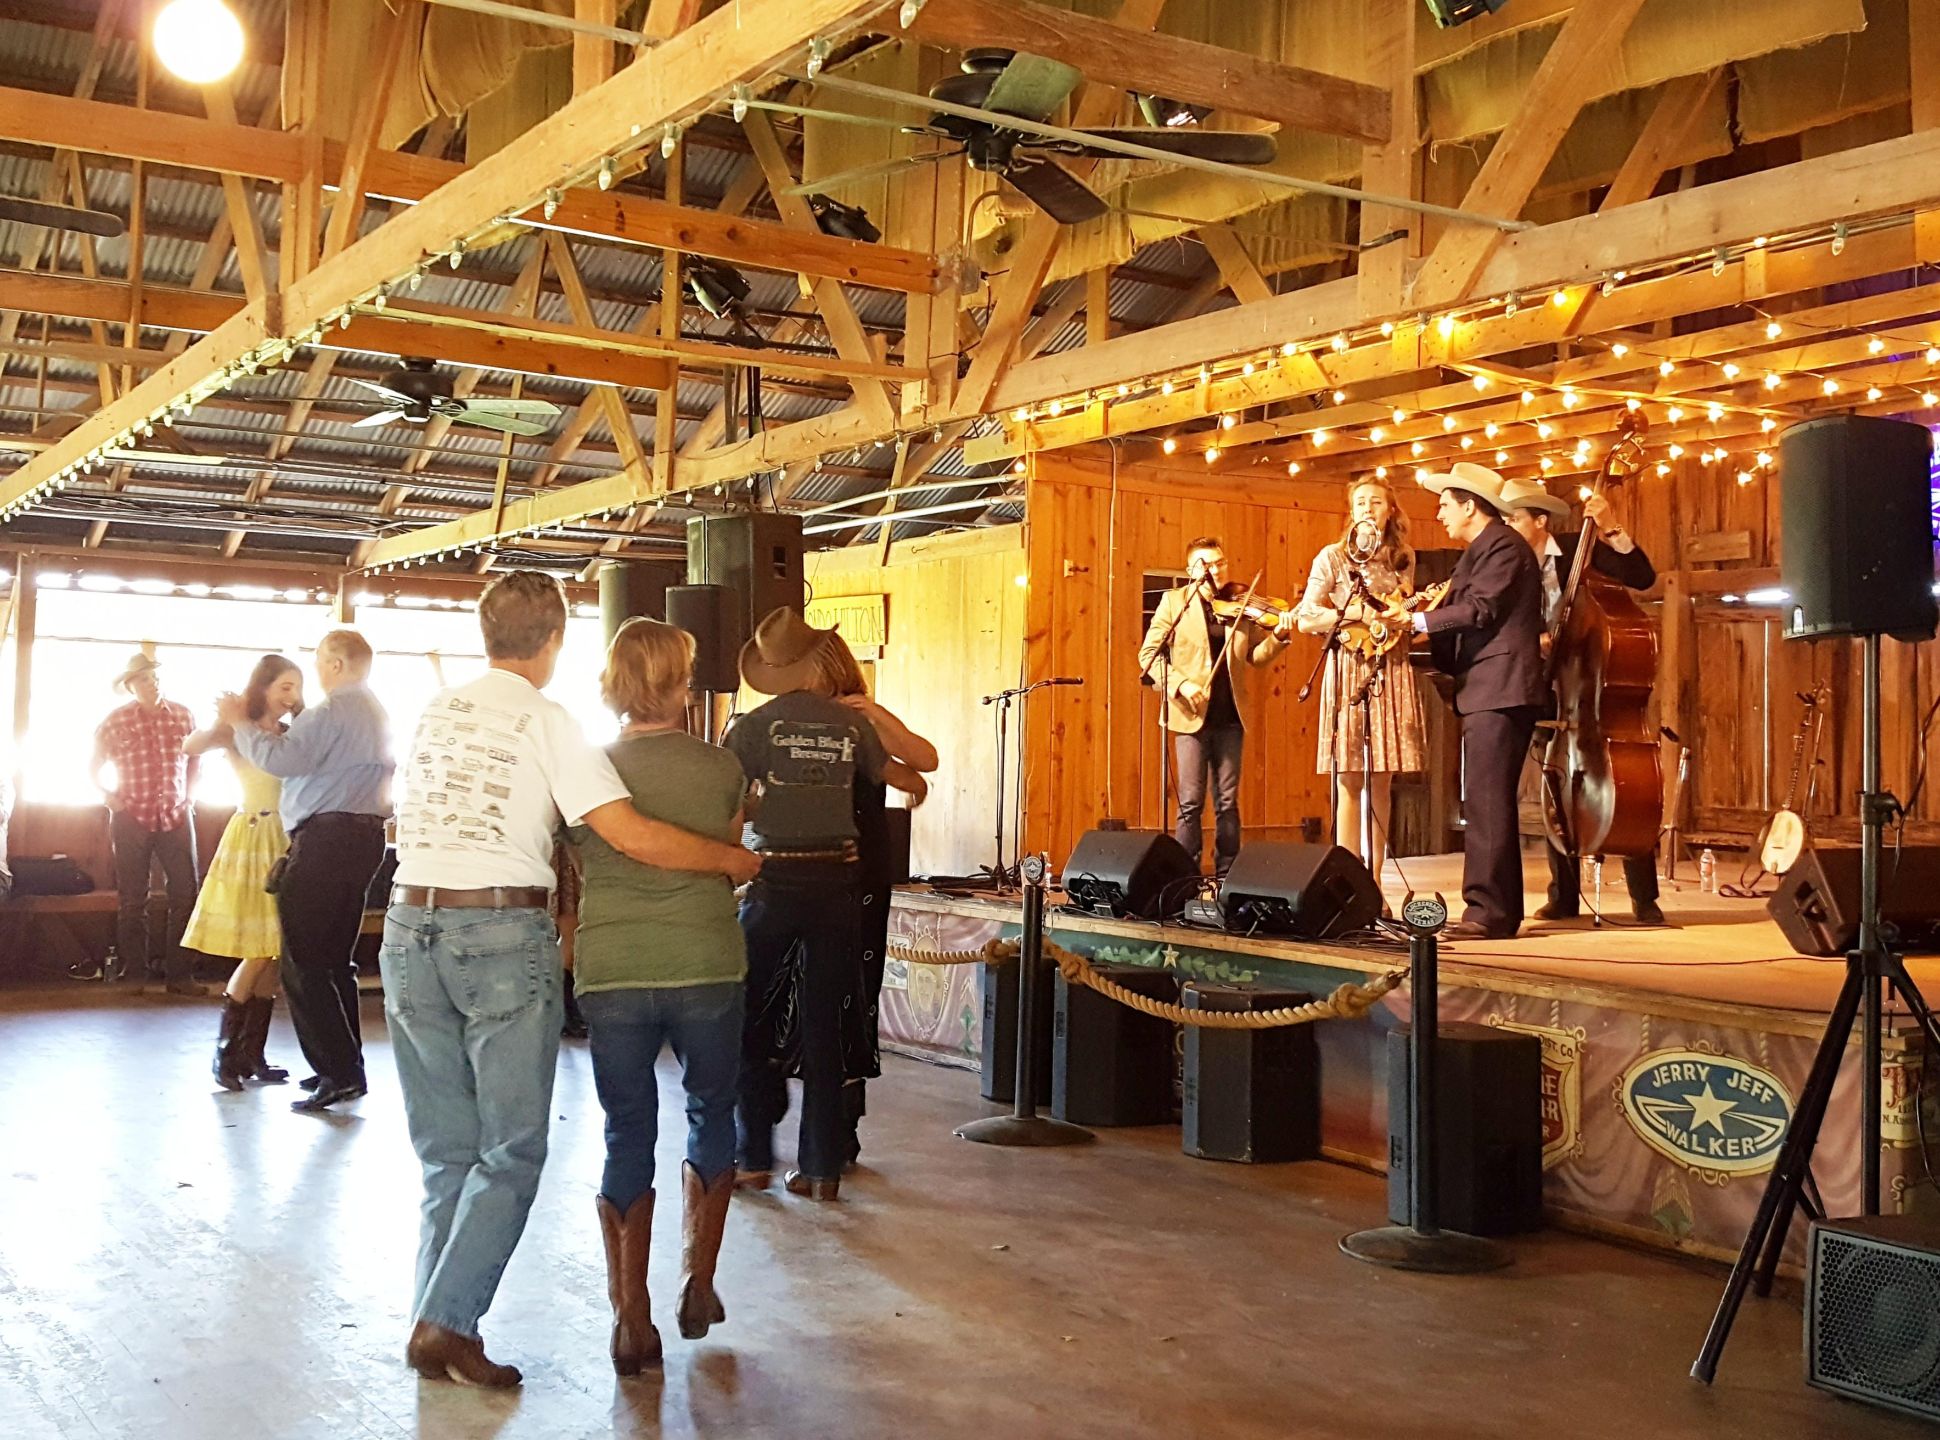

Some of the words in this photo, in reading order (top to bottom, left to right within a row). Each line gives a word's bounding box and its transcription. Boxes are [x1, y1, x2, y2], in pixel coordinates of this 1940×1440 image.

[833, 606, 884, 642] HILTON
[773, 735, 816, 747] Golden
[818, 736, 857, 752] Black
[790, 747, 838, 763] Brewery
[1652, 1063, 1710, 1088] JERRY
[1726, 1071, 1774, 1104] JEFF
[1664, 1119, 1757, 1157] WALKER
